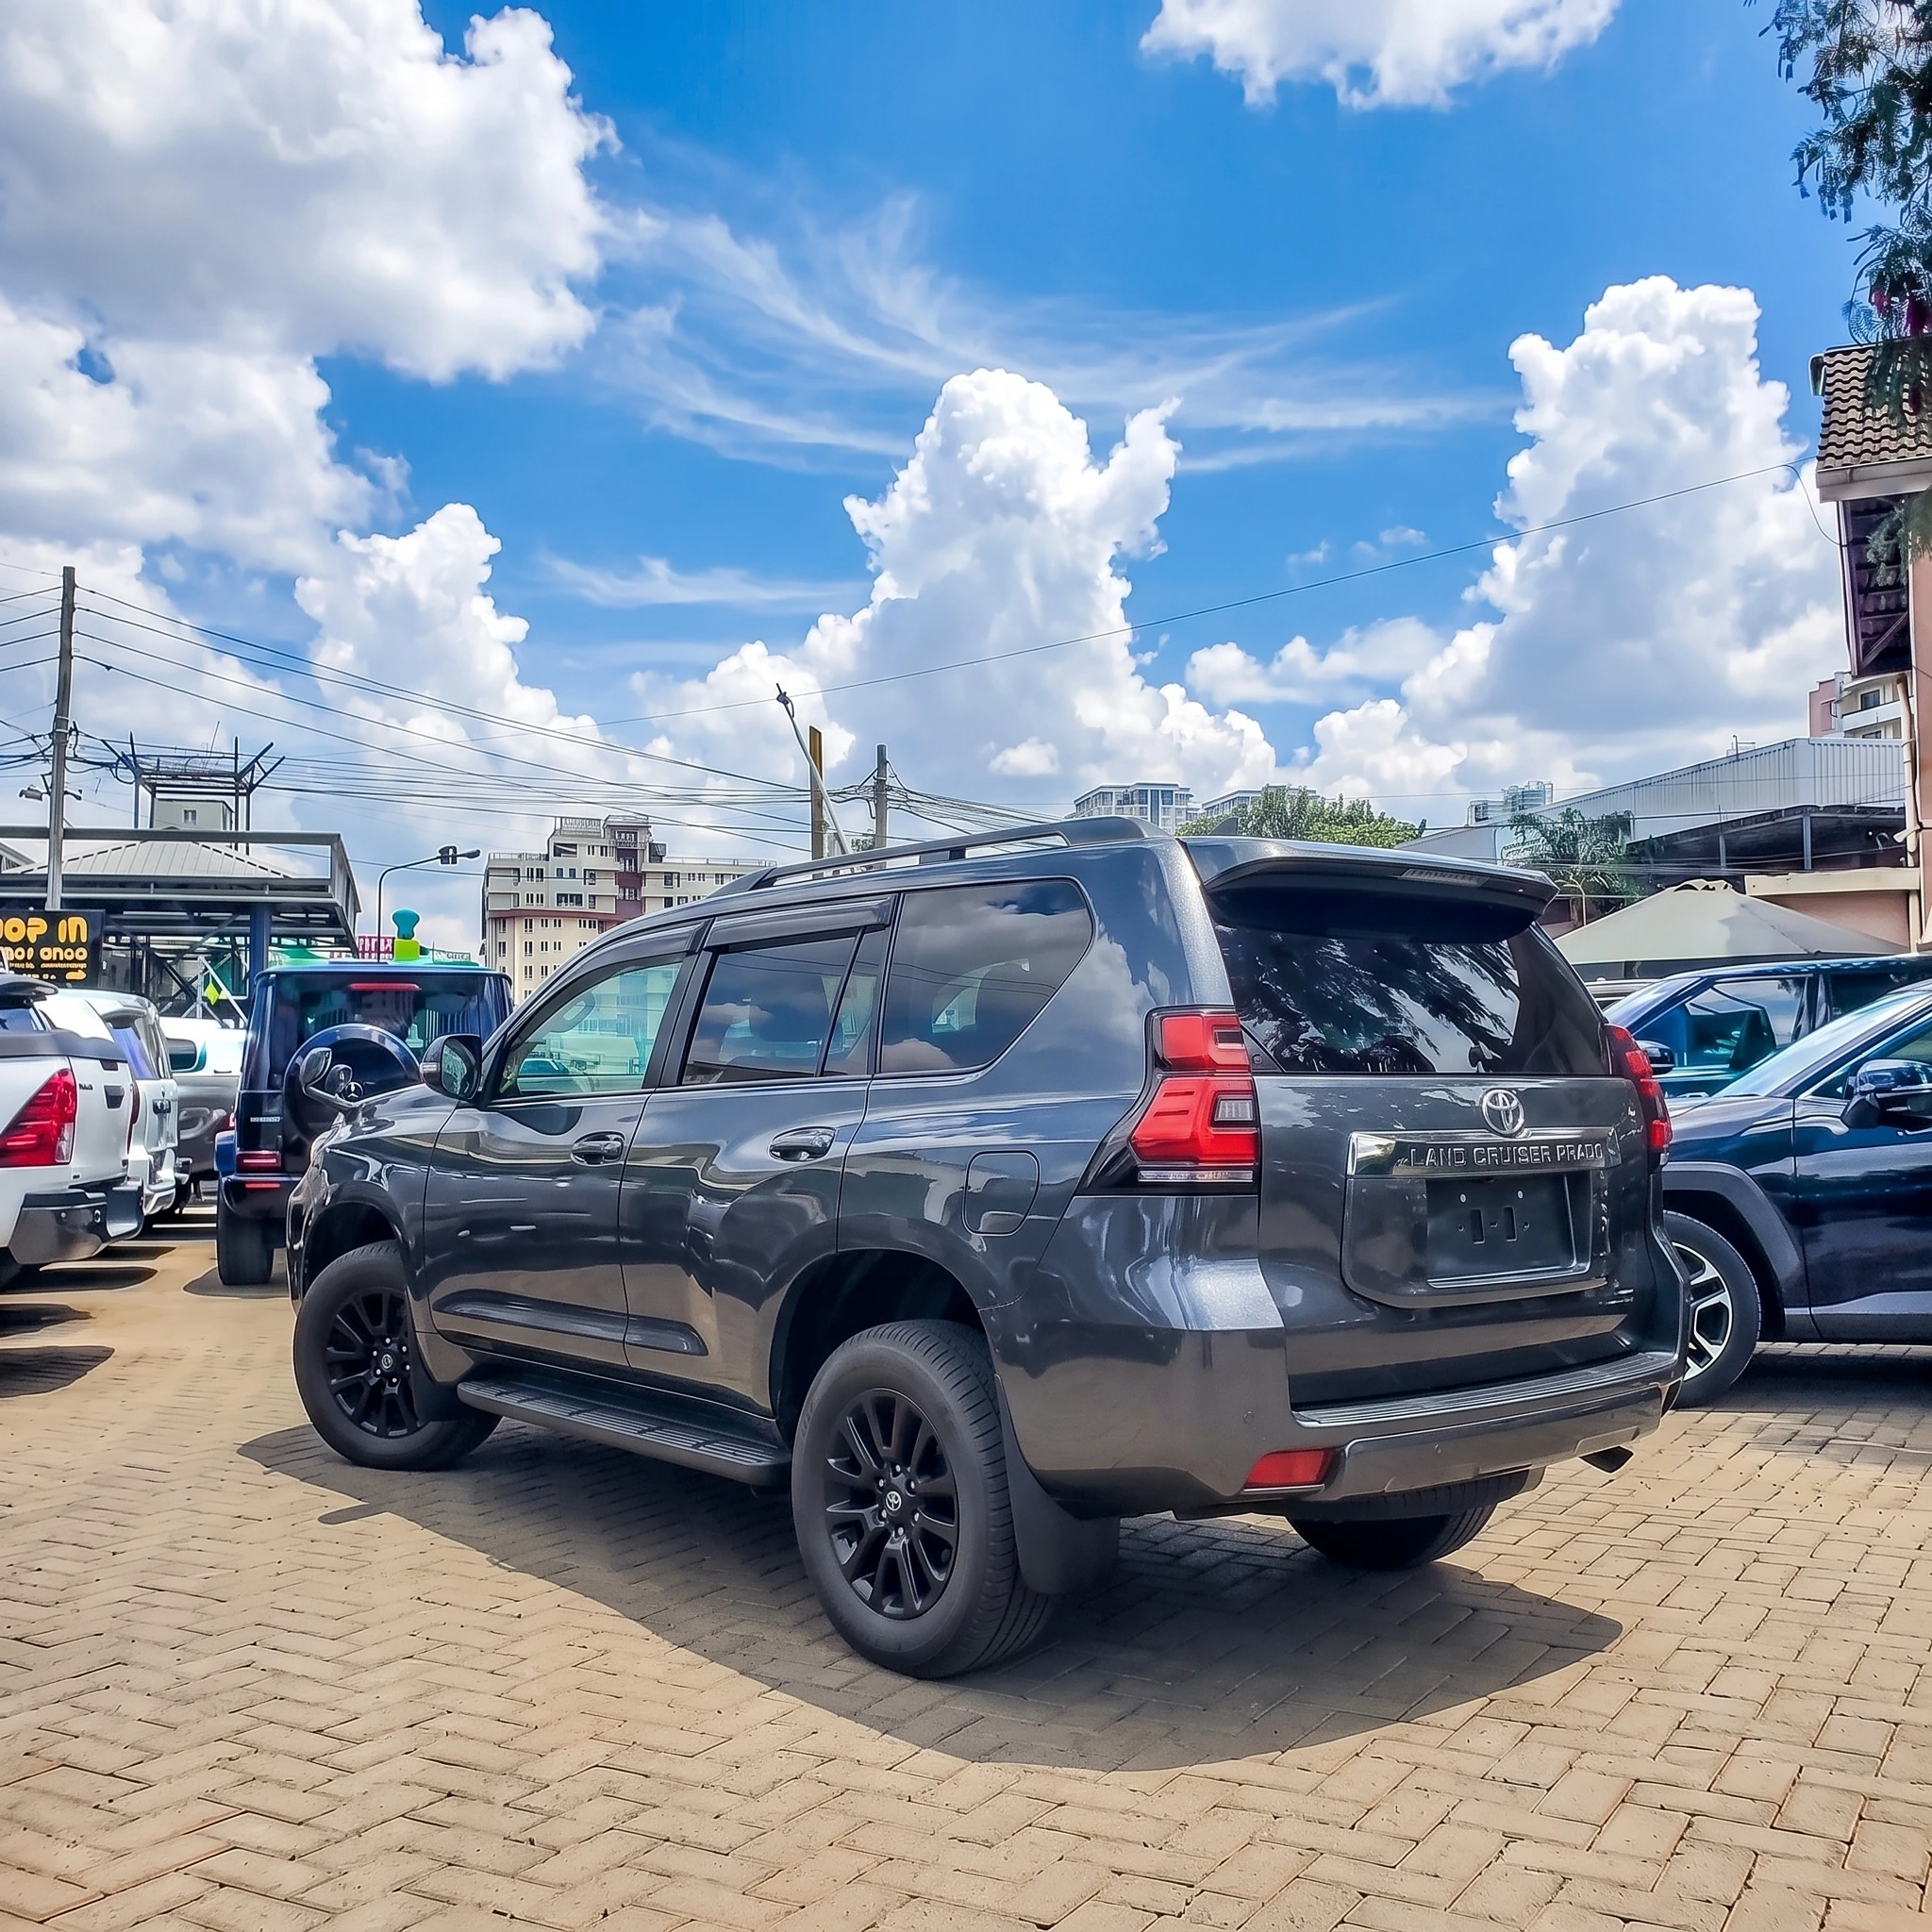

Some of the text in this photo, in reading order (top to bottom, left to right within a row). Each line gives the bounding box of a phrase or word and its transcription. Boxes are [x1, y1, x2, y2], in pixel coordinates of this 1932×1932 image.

[0, 917, 48, 943] OP
[1410, 1142, 1603, 1167] LAND CRUISER PRADO
